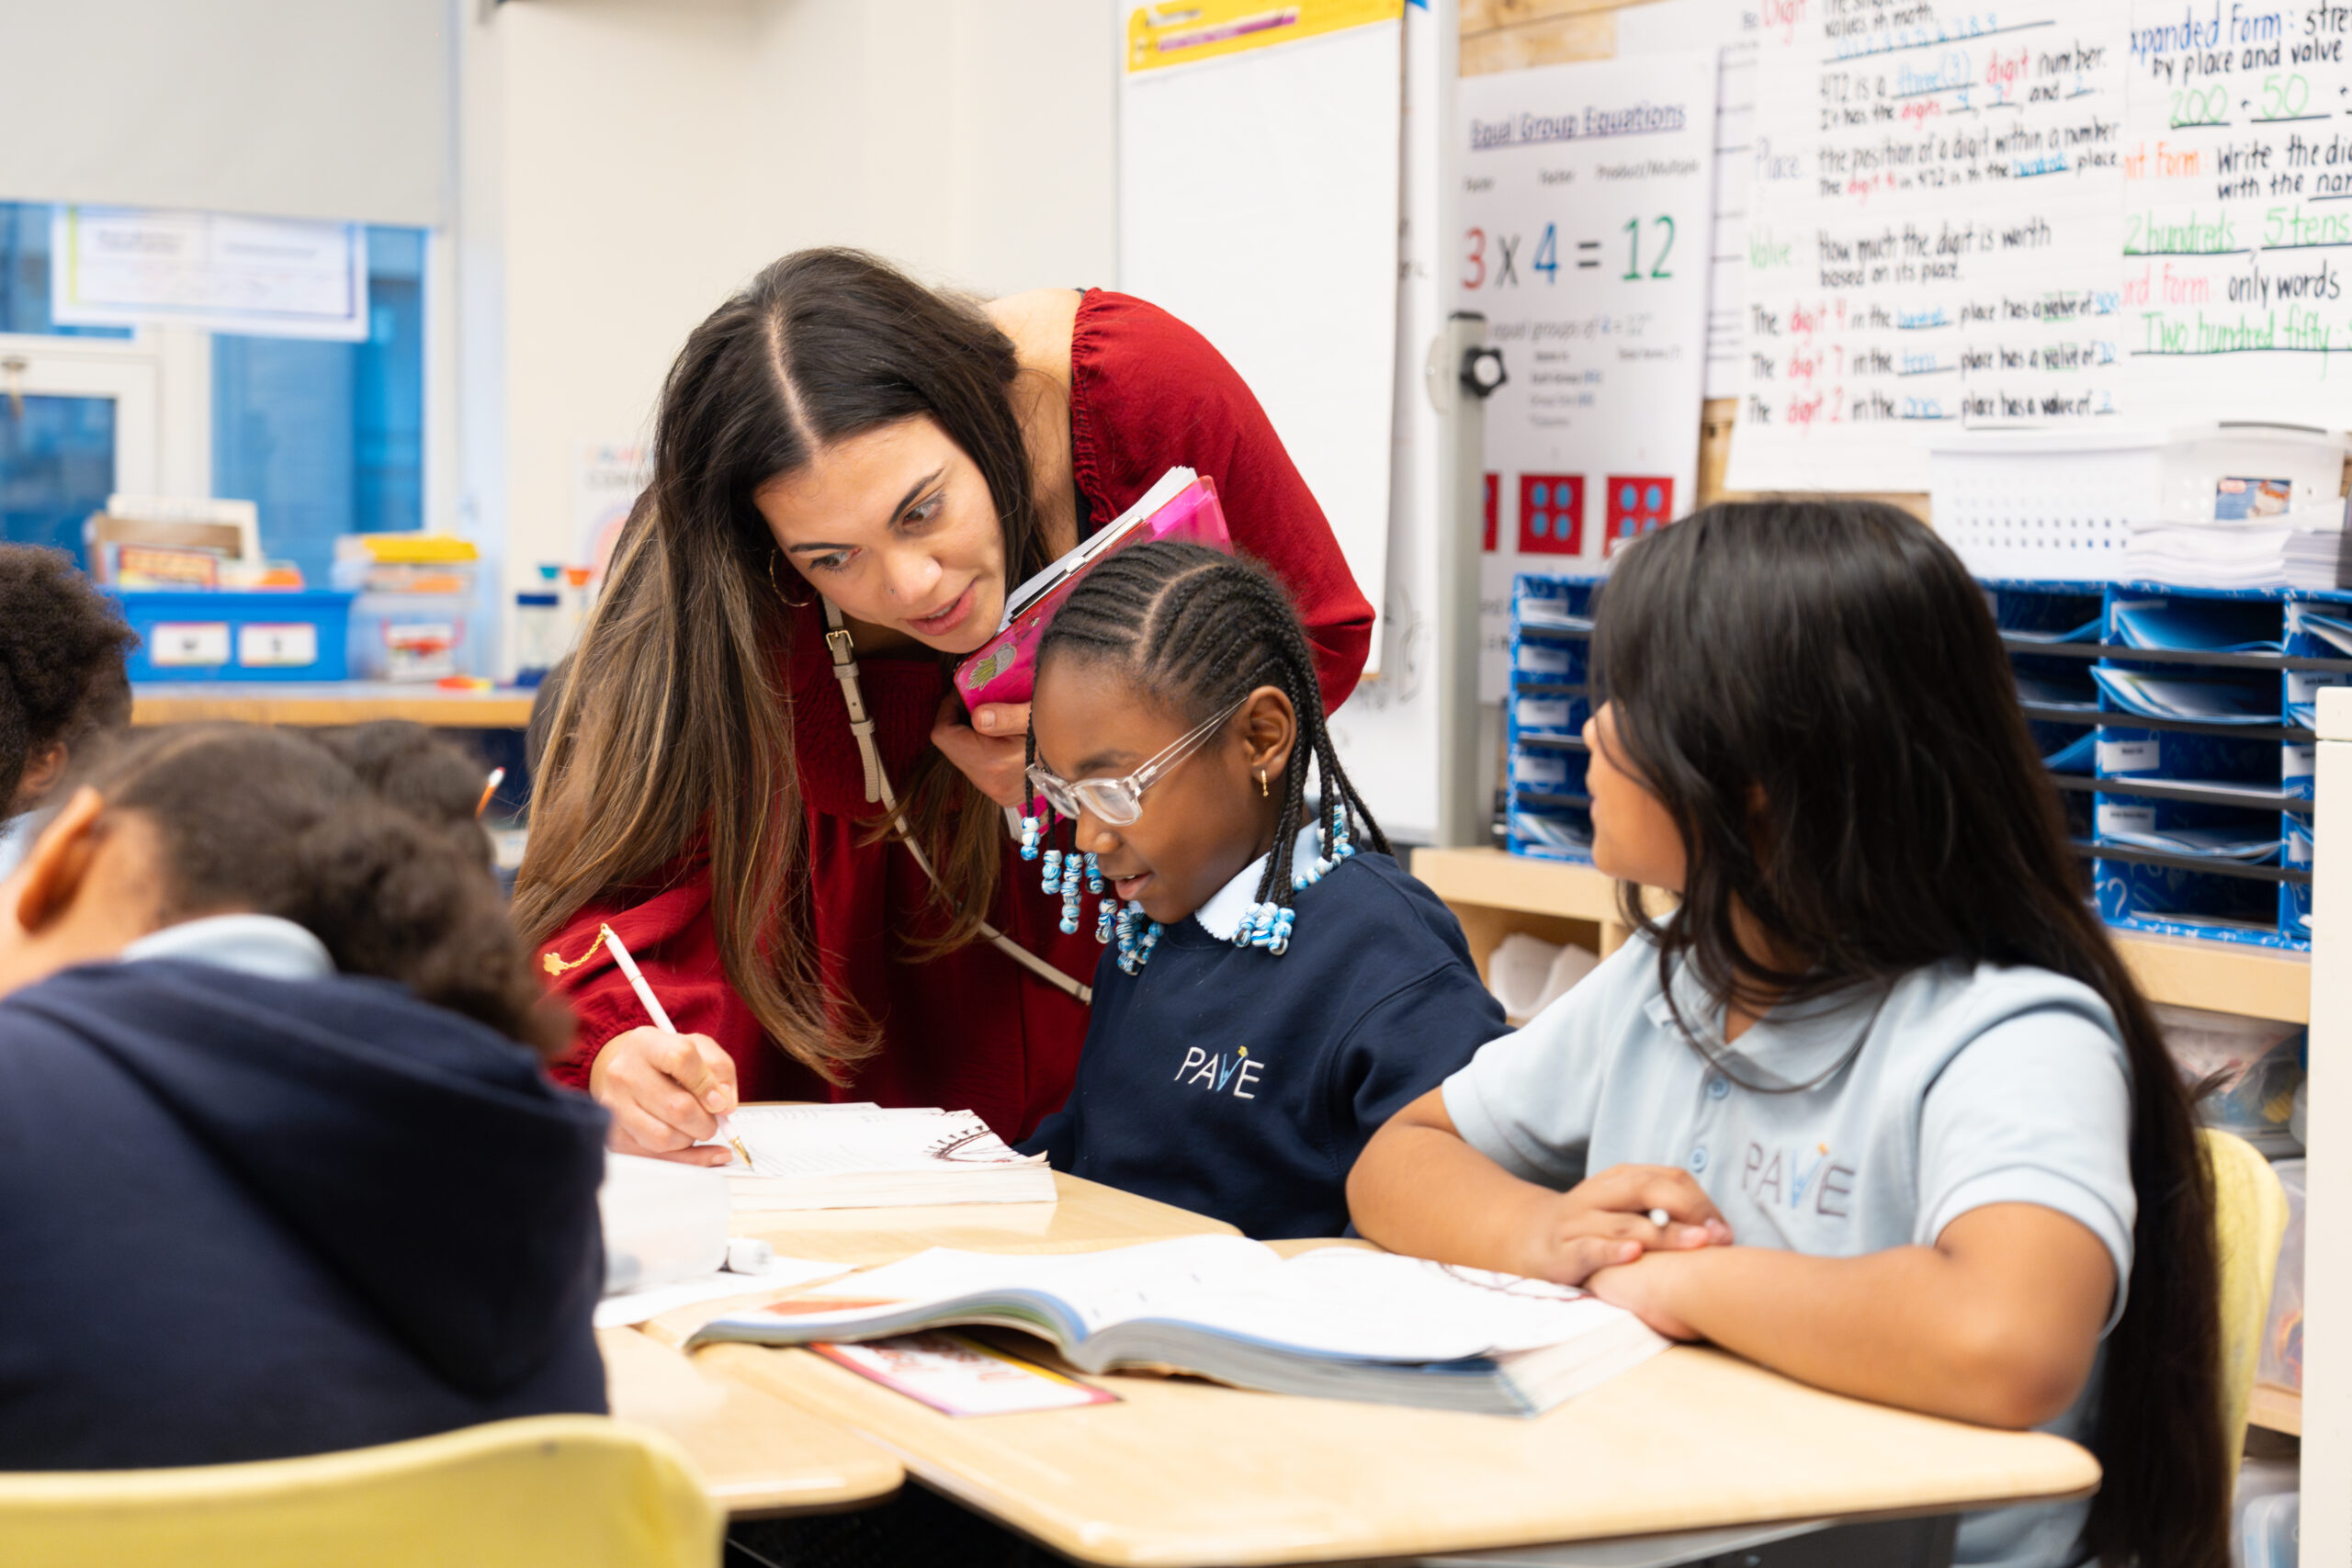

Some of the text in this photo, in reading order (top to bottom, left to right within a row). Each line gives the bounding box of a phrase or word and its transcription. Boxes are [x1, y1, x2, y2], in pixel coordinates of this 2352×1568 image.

[2130, 0, 2220, 65] xpanded
[2304, 0, 2352, 35] stre
[2154, 39, 2343, 86] by place and value
[1521, 112, 1578, 140] Group
[1584, 100, 1686, 135] Equations
[2169, 84, 2229, 126] 200
[2261, 73, 2310, 120] 50
[2218, 139, 2273, 174] Write
[2286, 133, 2319, 166] the
[2218, 175, 2259, 200] with
[2270, 172, 2304, 196] the
[1463, 226, 1487, 290] 3
[1533, 221, 1559, 285] 4
[1577, 243, 1601, 268] =
[1621, 214, 1676, 281] 12
[2228, 264, 2269, 310] only
[2277, 258, 2341, 300] words
[1173, 1045, 1265, 1100] PAVE
[1741, 1140, 1857, 1219] PAVE
